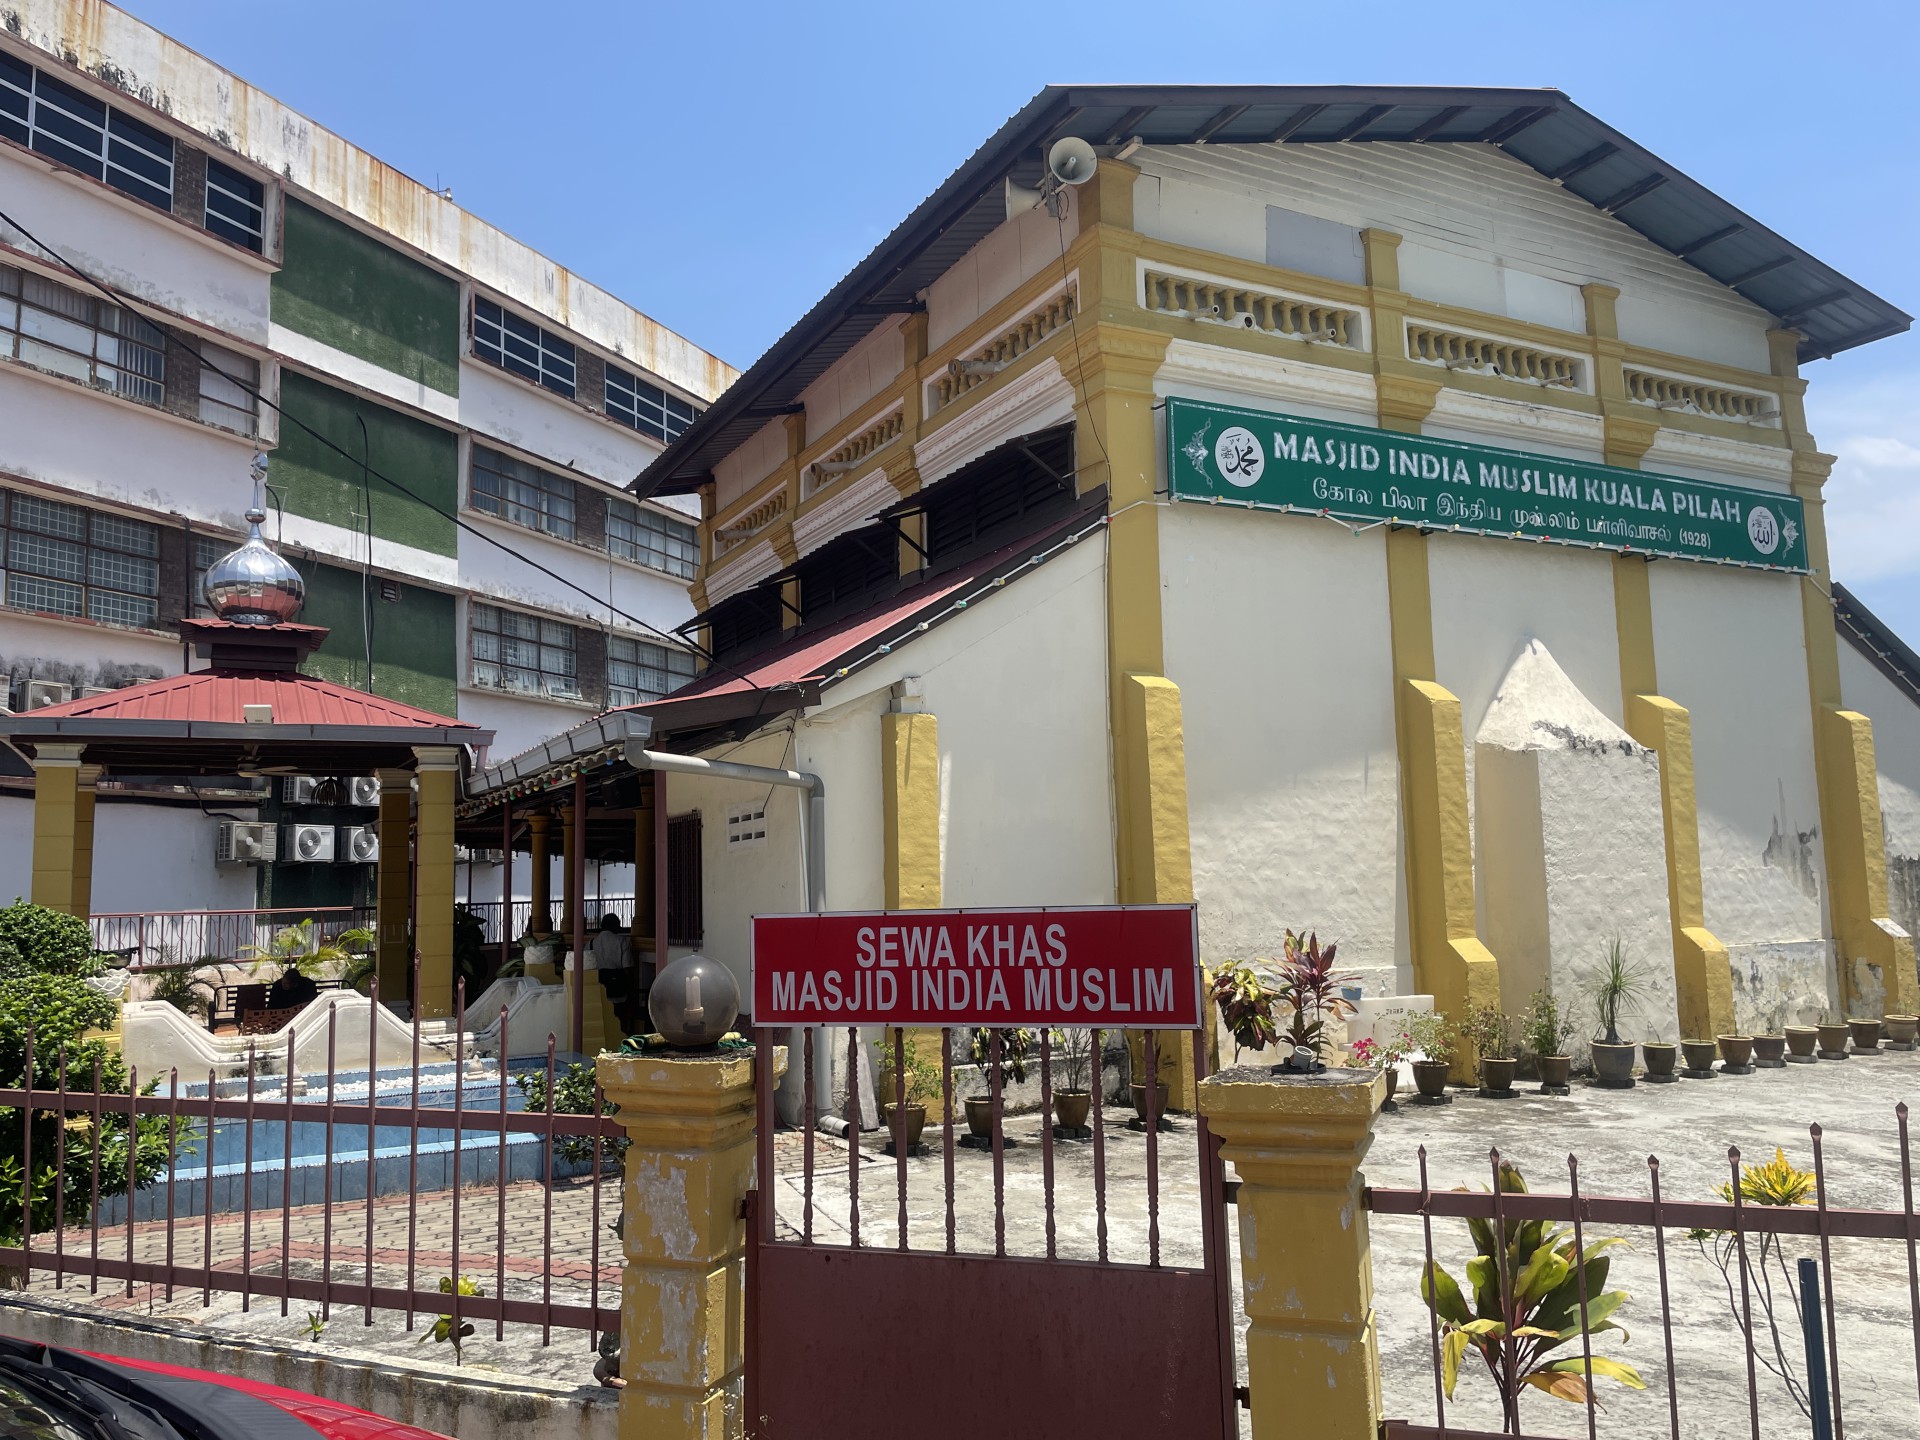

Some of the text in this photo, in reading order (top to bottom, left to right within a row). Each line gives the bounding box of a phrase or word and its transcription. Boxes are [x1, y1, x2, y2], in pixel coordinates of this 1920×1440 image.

[1273, 431, 1742, 524] MASJID INDIA MUSLIM KUALA PILAH
[1312, 476, 1373, 505] கோல
[1382, 485, 1428, 512] பிலா
[1436, 492, 1502, 522] இந்திய
[1678, 527, 1711, 550] (1928)
[856, 923, 1067, 968] SEWA KHAS
[772, 967, 1175, 1012] MASJID INDIA MUSLIM
